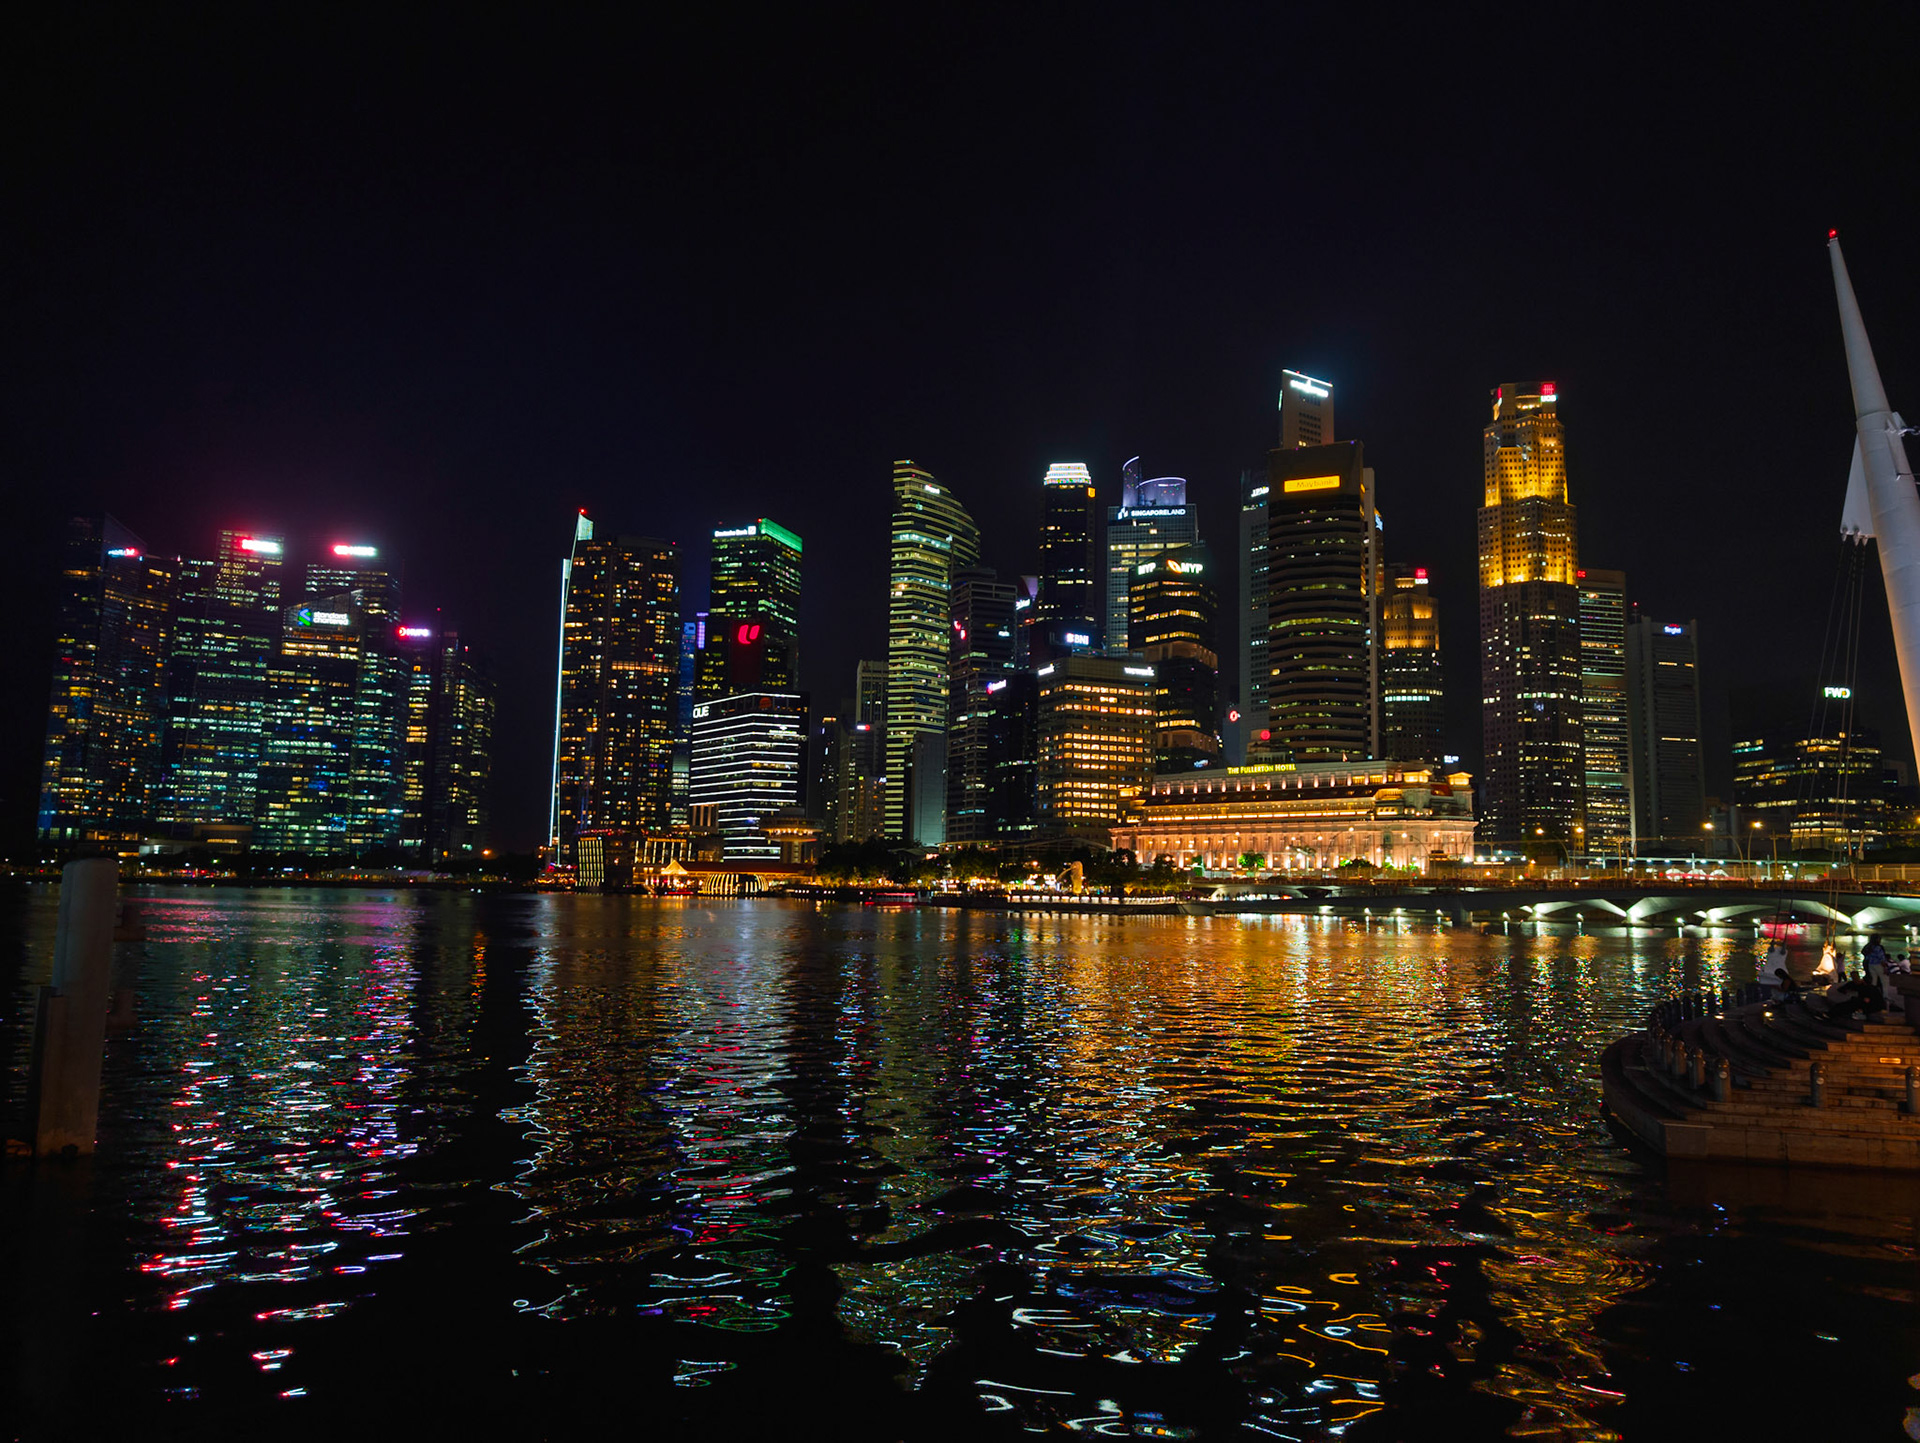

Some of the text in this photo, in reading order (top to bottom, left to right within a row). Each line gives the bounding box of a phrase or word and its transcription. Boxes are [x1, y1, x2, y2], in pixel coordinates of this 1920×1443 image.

[1295, 478, 1336, 489] Maybank
[1130, 509, 1186, 517] SINGAPORELAND
[1138, 562, 1156, 576] MYP
[1180, 562, 1203, 574] MYP
[313, 611, 348, 620] standard
[312, 617, 350, 626] chartered
[1074, 634, 1089, 645] BNI
[1824, 686, 1851, 699] FWD
[692, 706, 710, 719] OUE
[1227, 763, 1297, 775] THE FULLERTON HOTEL
